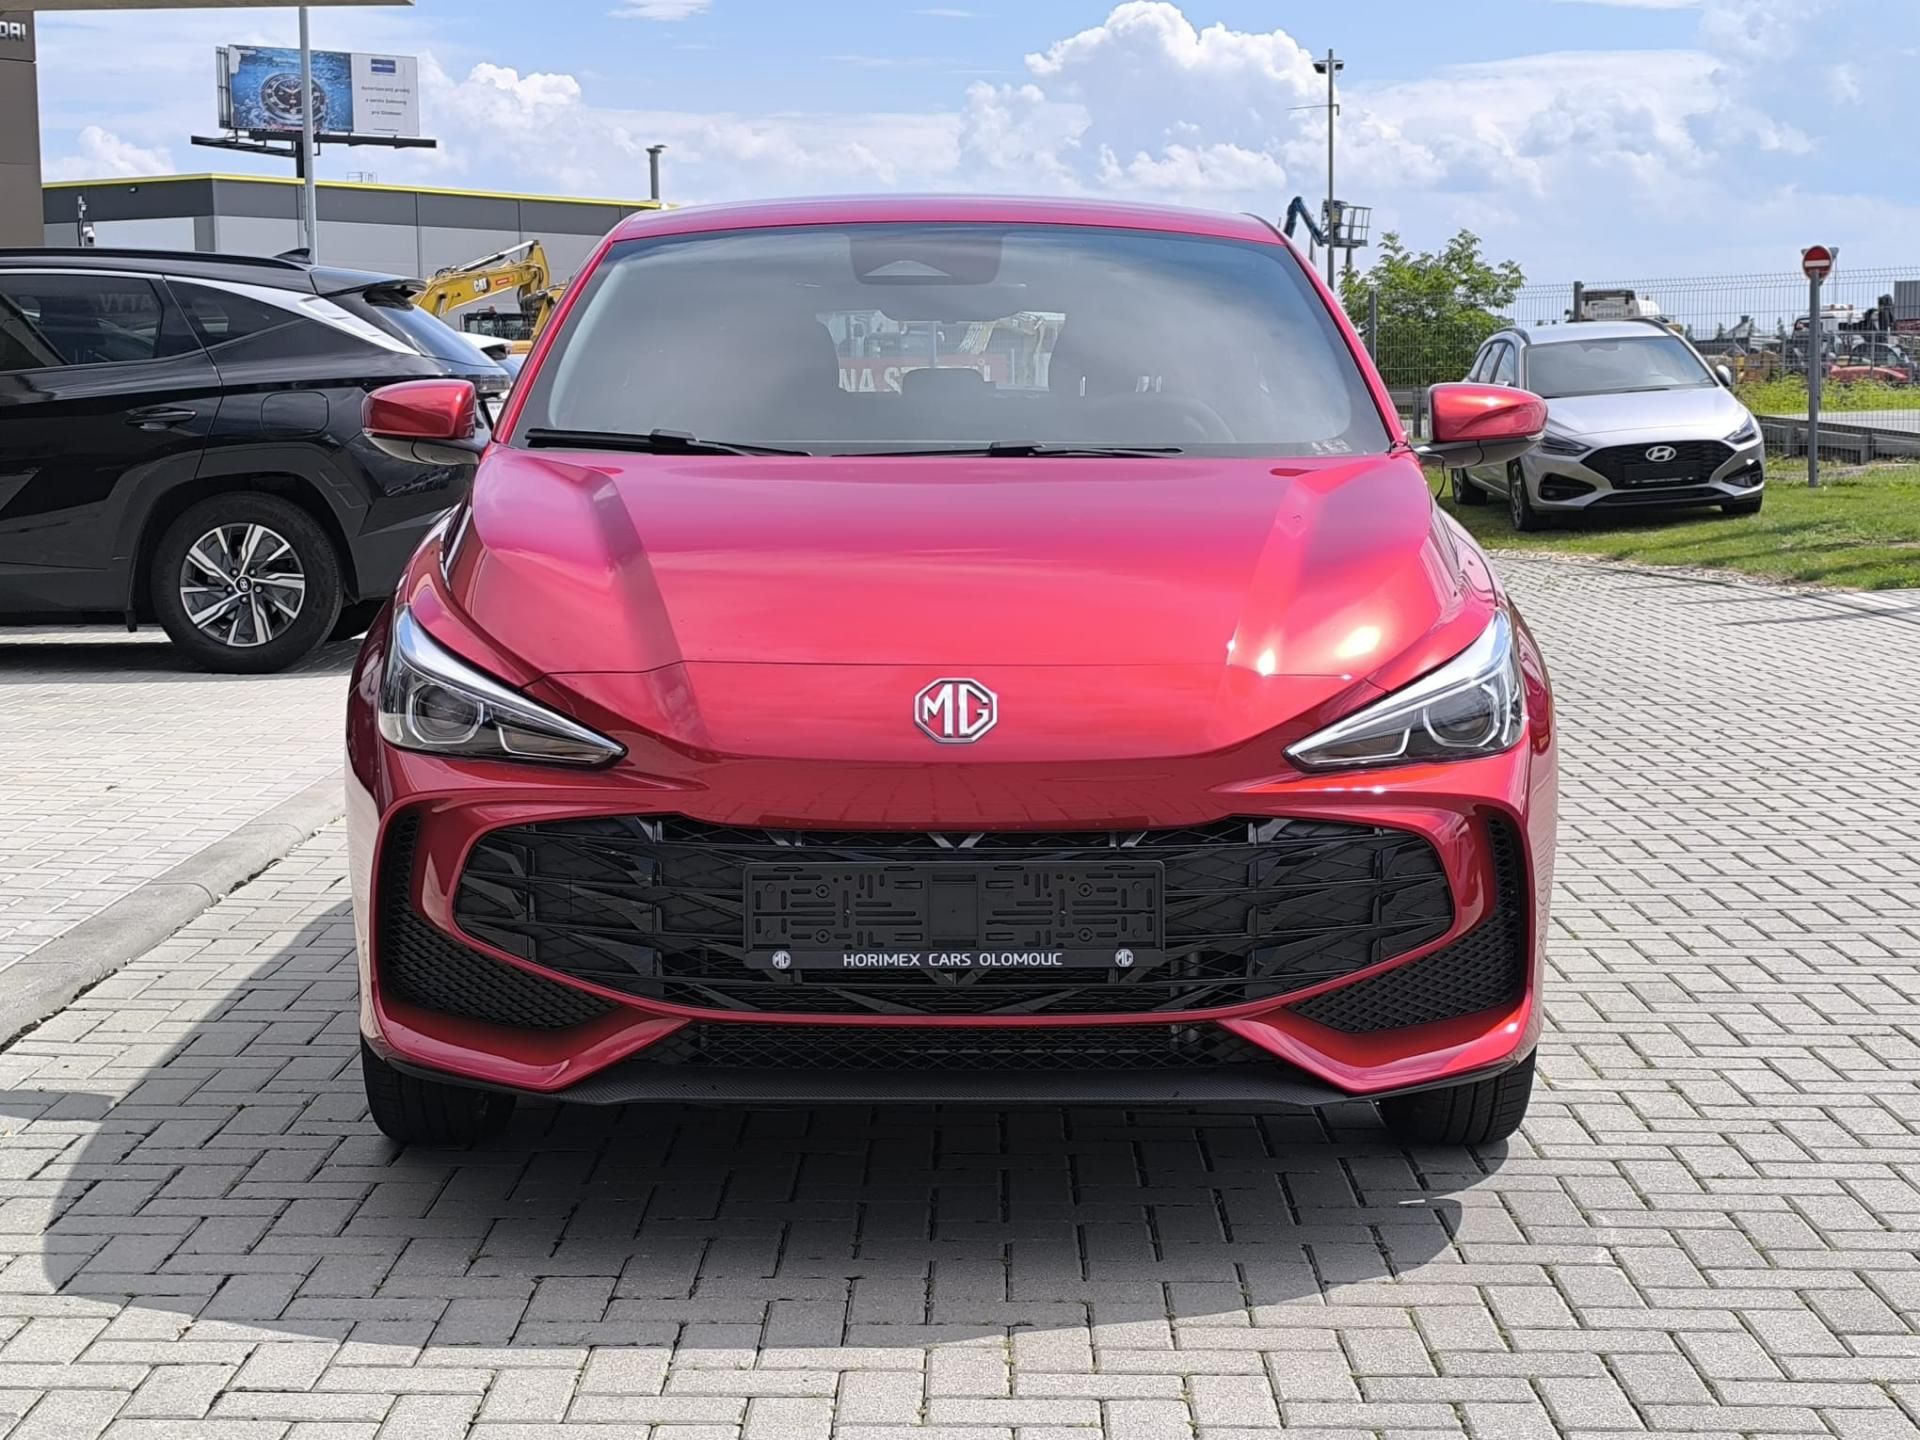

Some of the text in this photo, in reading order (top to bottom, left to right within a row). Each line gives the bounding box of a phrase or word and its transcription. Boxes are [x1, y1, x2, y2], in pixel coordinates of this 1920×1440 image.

[922, 682, 990, 737] MG
[772, 949, 1134, 969] MG HORIMEX CARS OLOMOUC MG
